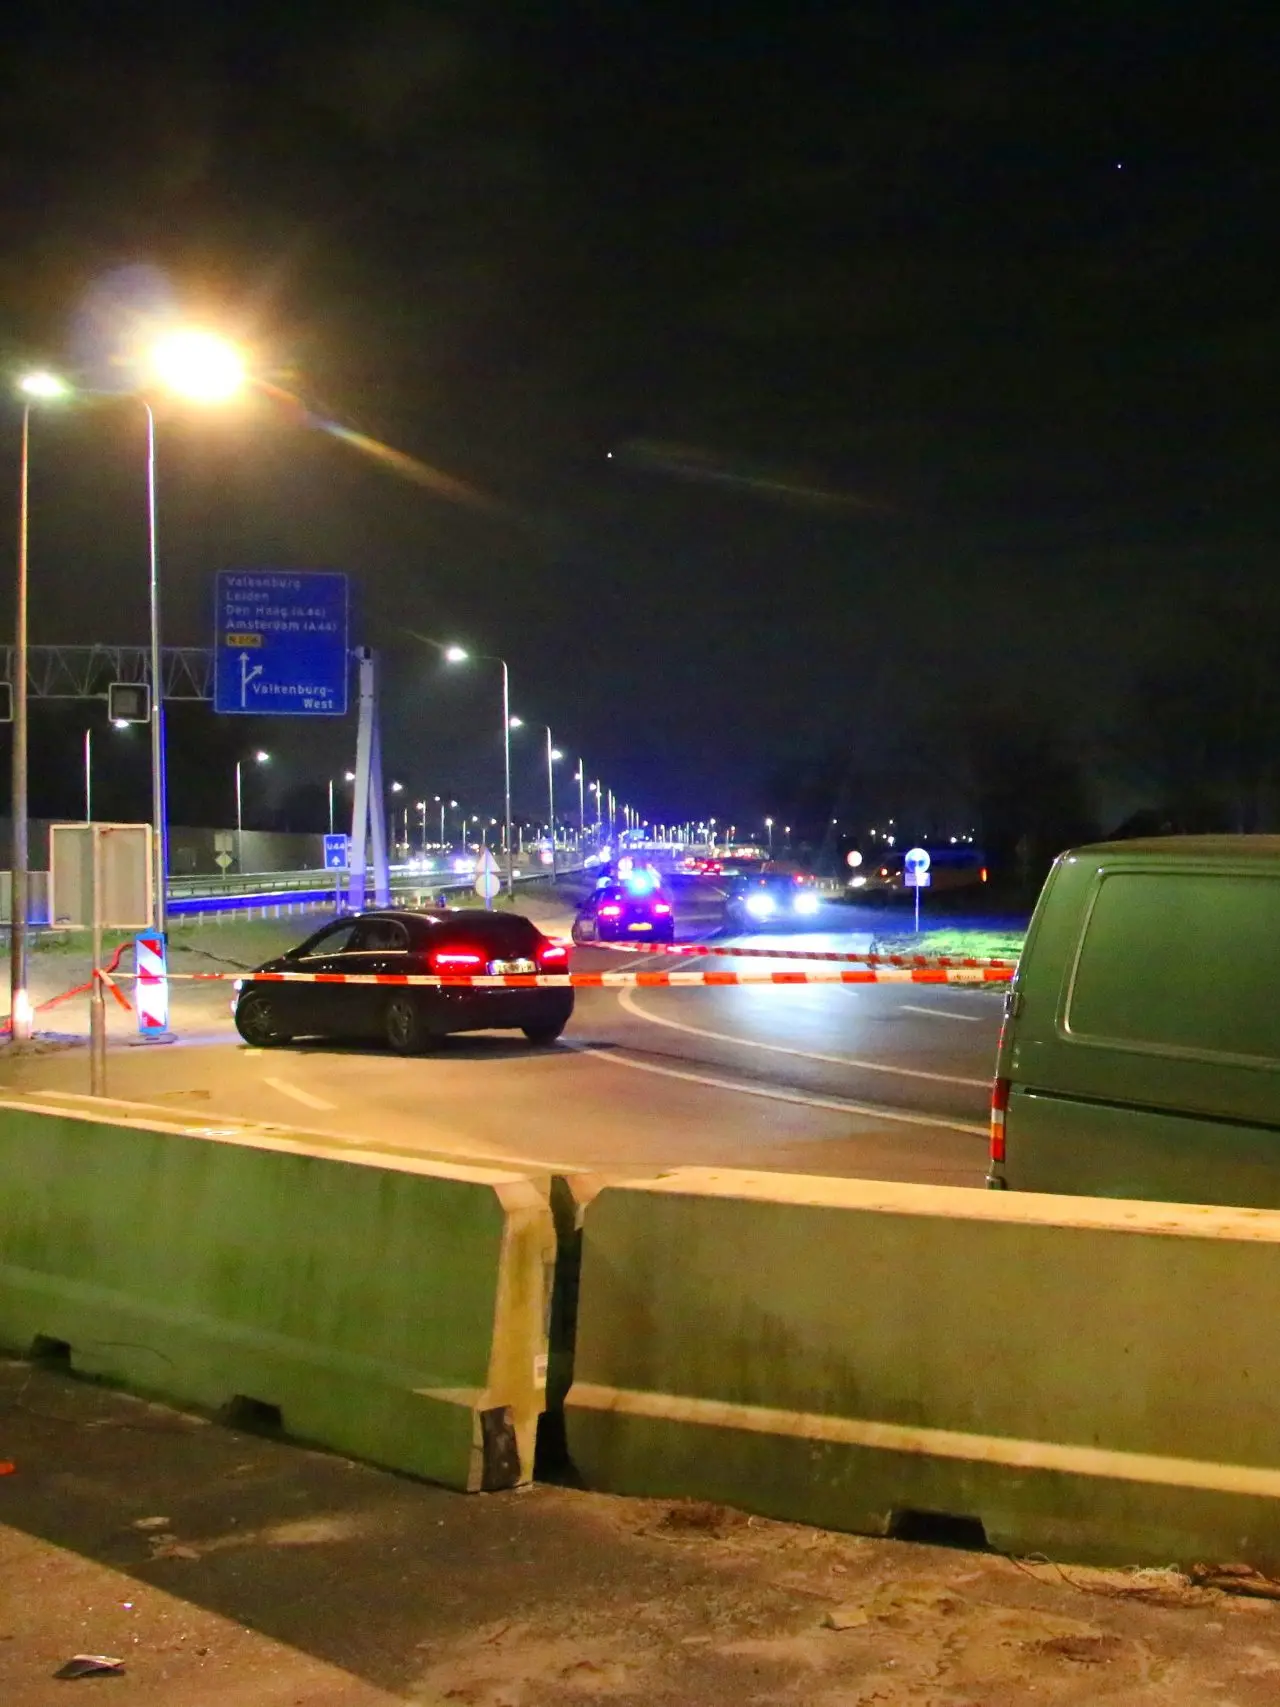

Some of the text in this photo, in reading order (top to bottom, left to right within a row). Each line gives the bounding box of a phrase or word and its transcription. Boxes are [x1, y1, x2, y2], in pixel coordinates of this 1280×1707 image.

[226, 591, 269, 601] Leiden
[226, 604, 250, 616] Den
[225, 619, 300, 631] Amsterdam
[303, 698, 333, 709] West
